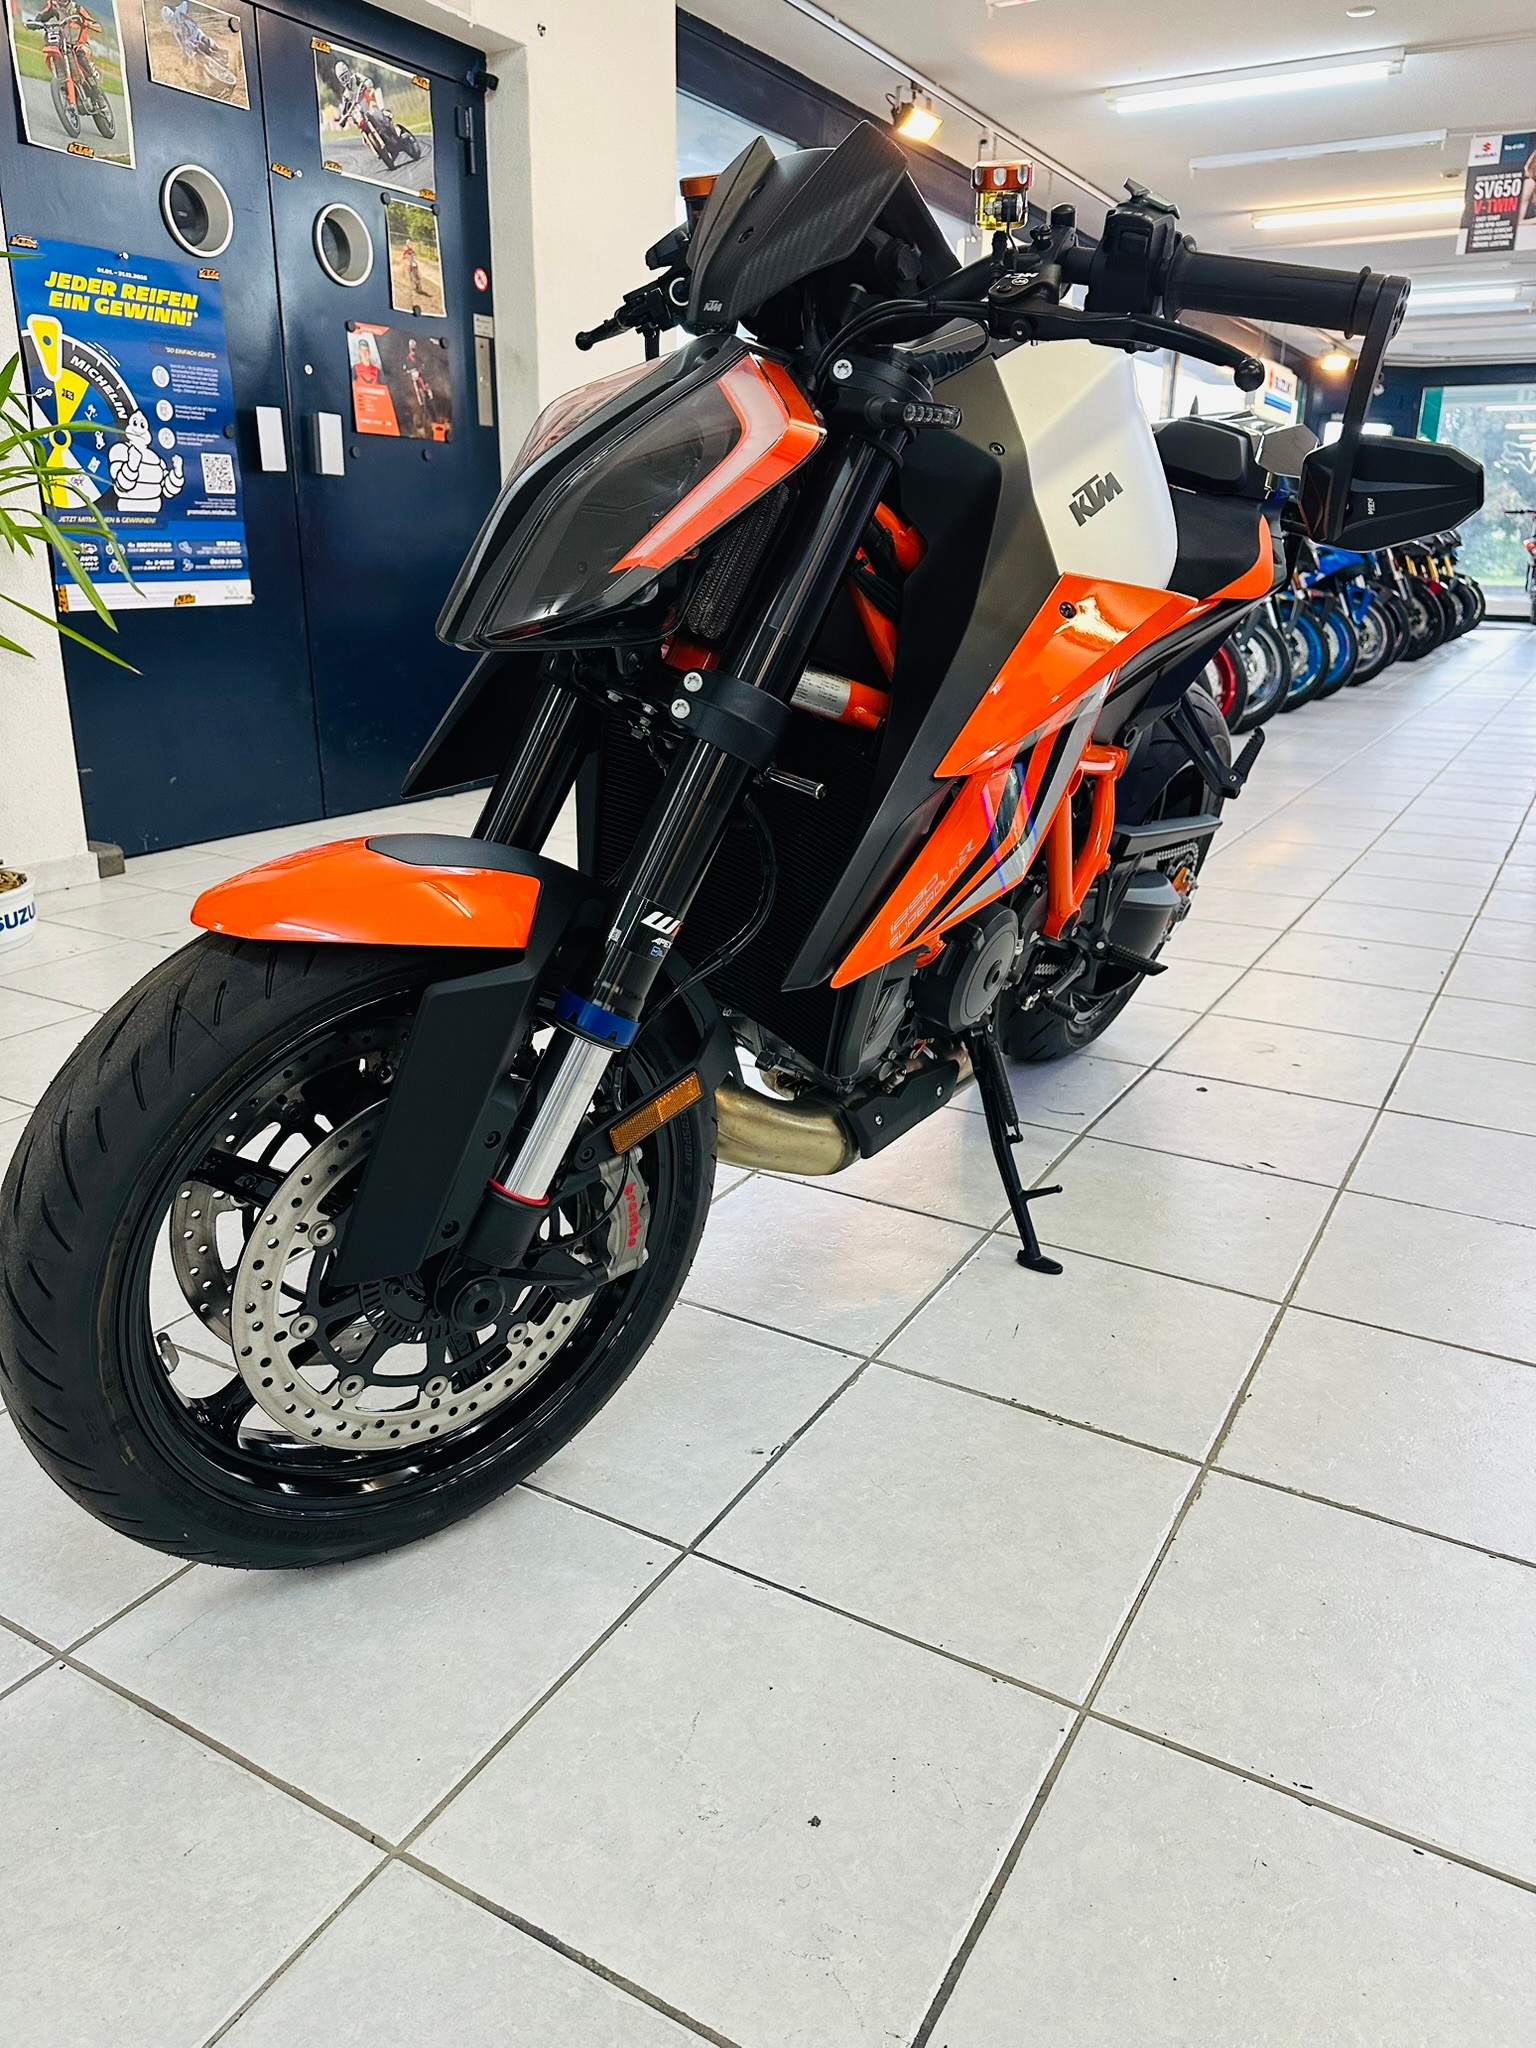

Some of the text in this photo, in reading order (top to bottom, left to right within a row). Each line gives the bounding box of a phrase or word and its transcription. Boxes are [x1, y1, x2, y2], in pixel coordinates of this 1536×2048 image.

[1473, 178, 1522, 200] SV650
[1473, 197, 1520, 214] V-TWIN
[44, 271, 199, 310] JEDER REIFEN
[48, 290, 91, 312] EIN
[703, 300, 723, 312] KTM
[69, 355, 128, 419] MICHELIN
[1068, 471, 1124, 527] KTM
[58, 516, 78, 524] JETZT
[890, 872, 939, 935] 1290
[623, 1182, 642, 1249] brembo
